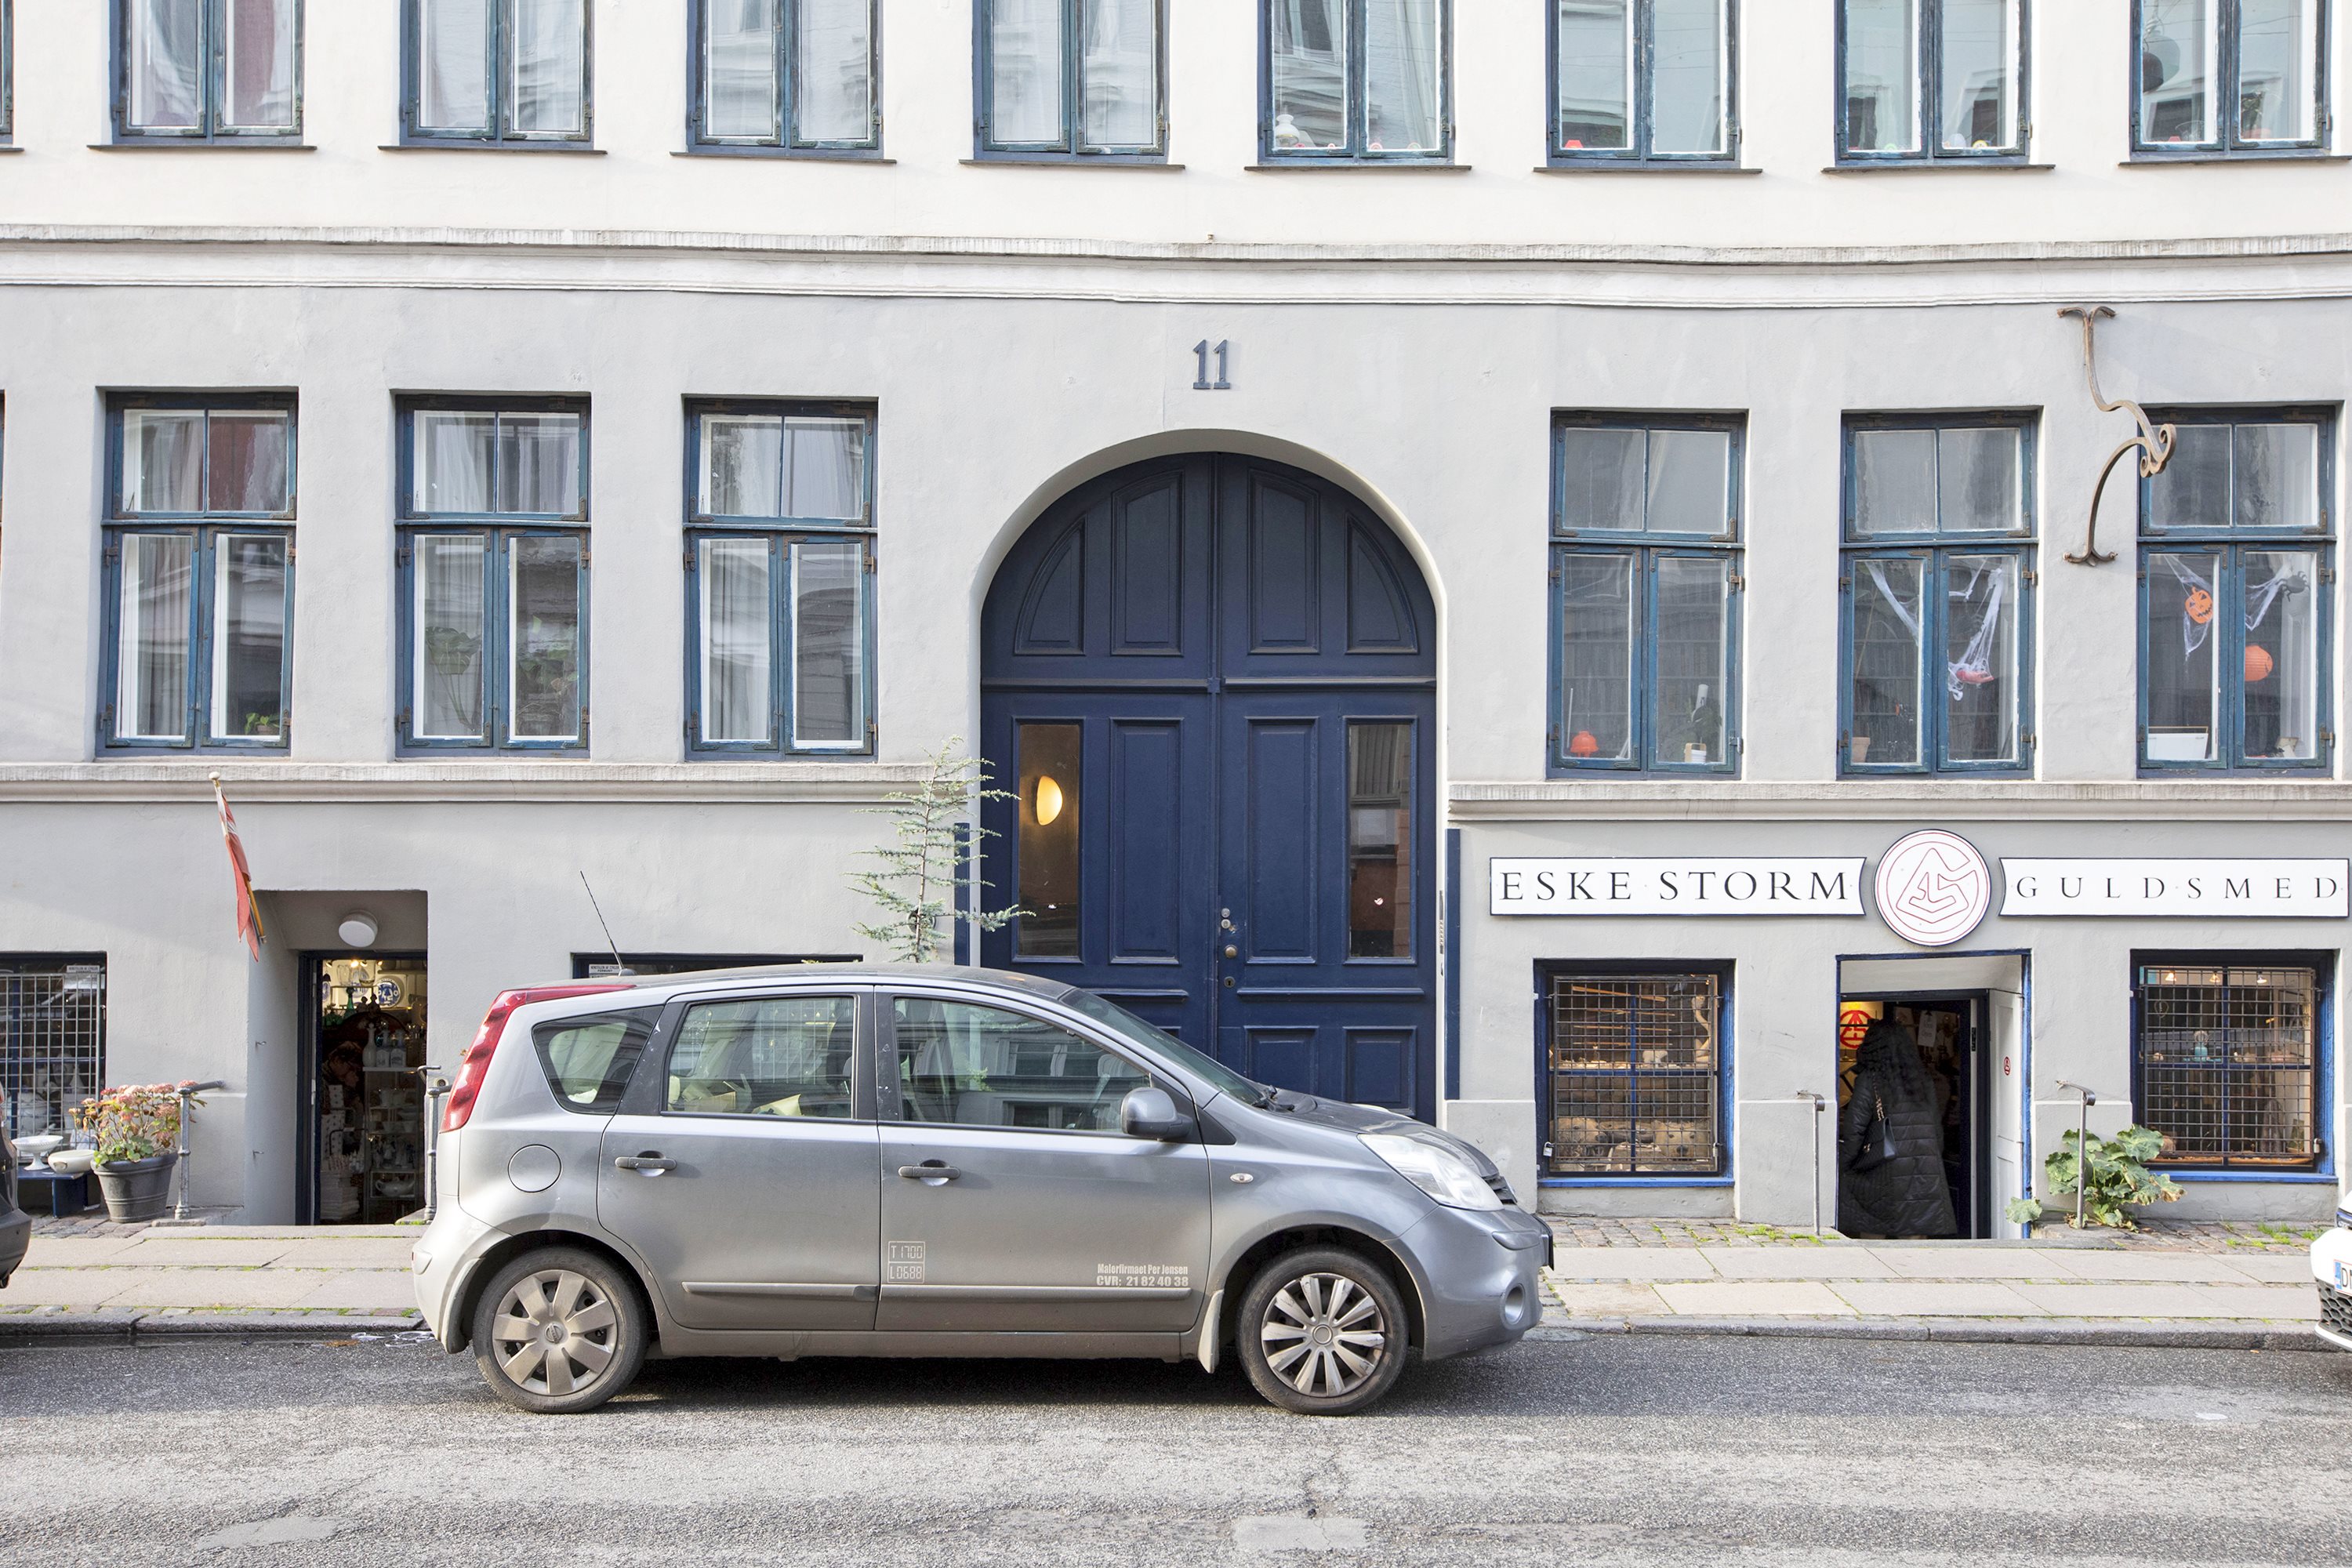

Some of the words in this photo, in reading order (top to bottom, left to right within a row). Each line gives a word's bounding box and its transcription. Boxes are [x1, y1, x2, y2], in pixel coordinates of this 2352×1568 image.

[1192, 339, 1231, 390] 11
[1498, 870, 1632, 901] ESKE
[1658, 870, 1849, 901] STORM
[2016, 876, 2338, 899] GULDSMED
[1098, 1263, 1146, 1275] Malerfirmaet
[1148, 1264, 1160, 1275] Per
[1161, 1264, 1189, 1275] Jensen
[1096, 1275, 1122, 1287] CVR:
[1126, 1276, 1138, 1287] 21
[1141, 1276, 1155, 1287] 82
[1156, 1276, 1171, 1287] 40
[1174, 1276, 1189, 1287] 38
